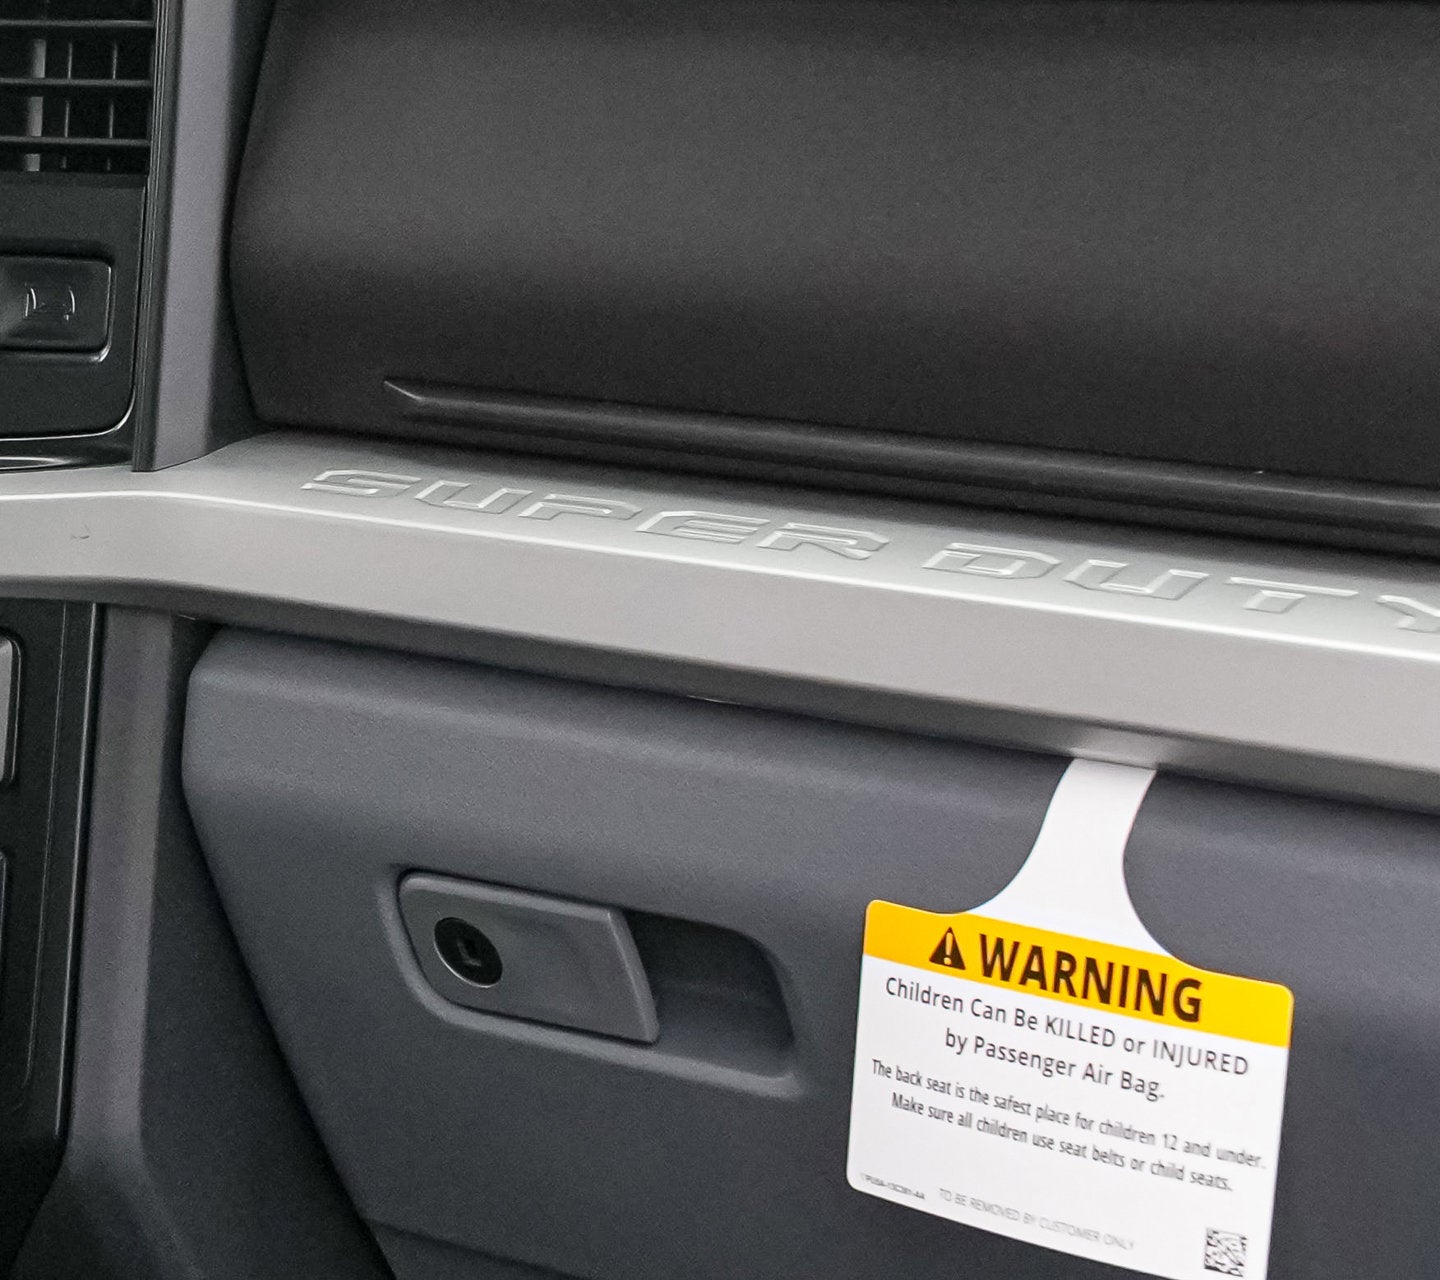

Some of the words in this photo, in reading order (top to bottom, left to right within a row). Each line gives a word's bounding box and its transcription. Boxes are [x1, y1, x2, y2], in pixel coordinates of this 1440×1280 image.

[300, 469, 890, 561] SUPER
[979, 933, 1203, 1023] WARNING
[886, 977, 963, 1013] Children
[971, 999, 1006, 1023] Can
[1014, 1008, 1037, 1030] Be
[1046, 1015, 1115, 1047] KILLED
[1124, 1038, 1145, 1054] or
[1153, 1040, 1248, 1075] INJURED
[946, 1028, 968, 1055] by
[974, 1036, 1076, 1077] Passenger
[1082, 1063, 1113, 1085] Air
[1121, 1071, 1164, 1102] Bag.
[872, 1059, 892, 1078] The
[896, 1065, 922, 1086] back
[926, 1078, 951, 1095] seat
[956, 1082, 965, 1098] is
[970, 1087, 989, 1105] the
[994, 1095, 1032, 1116] safest
[1036, 1105, 1070, 1125] place
[1076, 1112, 1094, 1130] for
[1099, 1121, 1155, 1144] children
[1163, 1134, 1177, 1150] 12
[1184, 1141, 1210, 1157] and
[892, 1092, 924, 1115] Make
[928, 1106, 954, 1123] sure
[958, 1112, 972, 1128] all
[977, 1117, 1027, 1142] children
[1033, 1135, 1054, 1150] use
[1059, 1141, 1087, 1158] seat
[1092, 1146, 1125, 1167] belts
[1131, 1159, 1145, 1170] or
[1151, 1161, 1184, 1181] child
